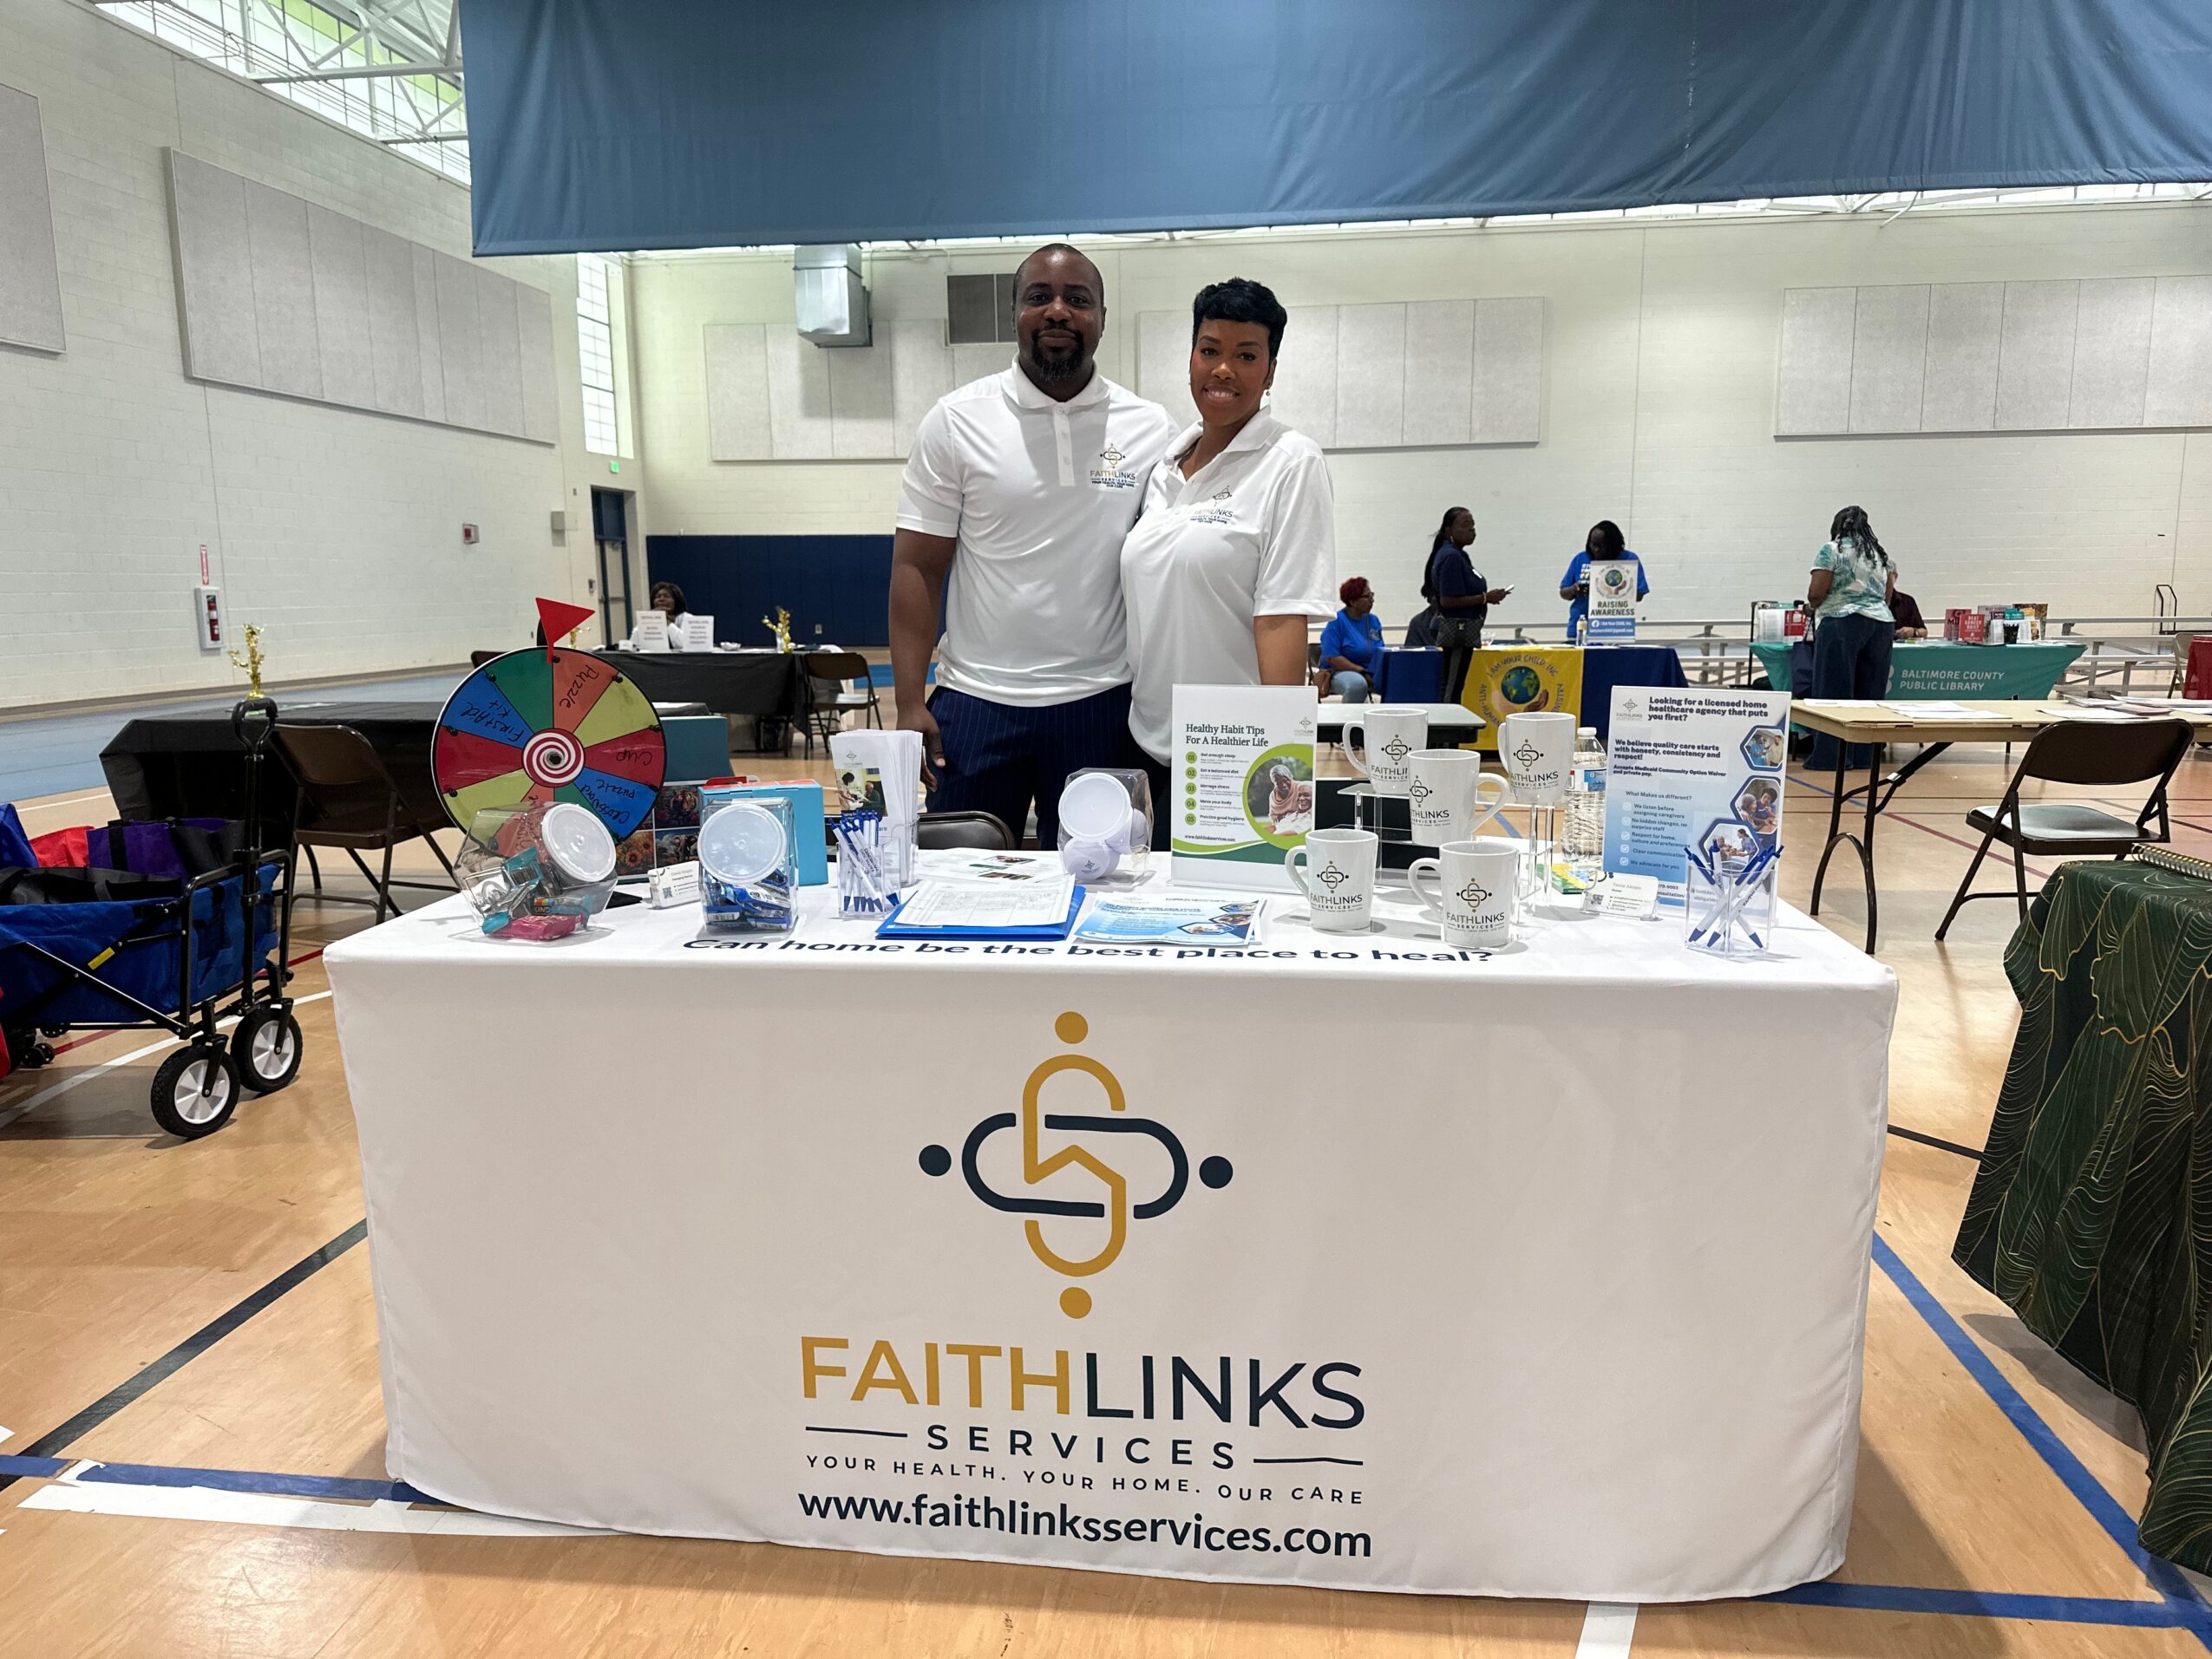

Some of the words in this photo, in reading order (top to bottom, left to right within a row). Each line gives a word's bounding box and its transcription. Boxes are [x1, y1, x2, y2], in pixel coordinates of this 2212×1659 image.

[1090, 470, 1135, 480] FAITHLINKS
[1523, 655, 1545, 666] CHILD
[1546, 664, 1558, 676] INC
[1901, 669, 1960, 680] BALTIMORE
[1962, 671, 2006, 680] COUNTY
[1900, 681, 1938, 689] PUBLIC
[1940, 682, 1985, 690] LIBRARY
[1650, 696, 1683, 706] Looking
[1705, 699, 1742, 708] licensed
[1186, 724, 1219, 735] Healthy
[1221, 725, 1244, 734] Habit
[1246, 726, 1265, 736] Tips
[1186, 735, 1201, 744] For
[1211, 736, 1250, 746] Healthier
[1253, 738, 1268, 747] Life
[1662, 749, 1705, 758] consistency
[1310, 893, 1363, 905] FAITHLINKS
[1446, 911, 1504, 924] FAITHLINKS
[683, 939, 764, 949] Can
[779, 940, 900, 952] home
[915, 944, 959, 953] be
[982, 944, 1055, 955] the
[1067, 945, 1164, 957] best
[1176, 947, 1298, 959] place
[1313, 949, 1359, 959] to
[1371, 950, 1492, 962] heal?
[802, 1336, 1365, 1429] FAITHLINKS
[927, 1425, 1234, 1470] SERVICES
[807, 1455, 875, 1471] YOUR
[893, 1460, 1005, 1481] HEALTH.
[1024, 1471, 1093, 1490] YOUR
[1112, 1478, 1201, 1493] HOME.
[1218, 1485, 1273, 1501] OUR
[1291, 1486, 1363, 1505] CARE
[798, 1492, 1371, 1558] www.faithlinksservices.com
